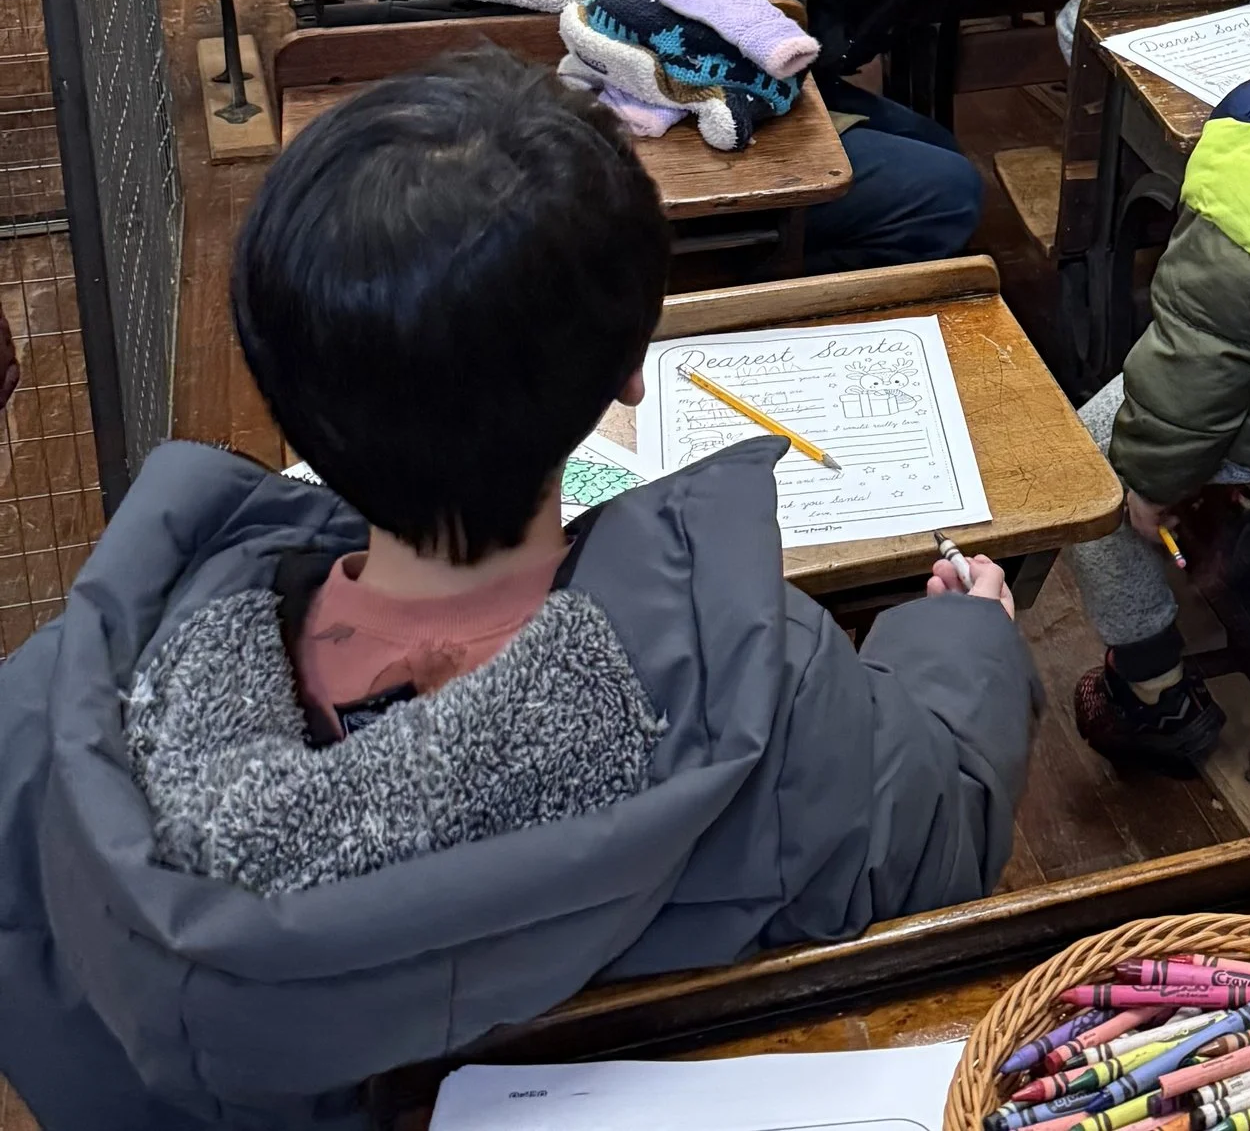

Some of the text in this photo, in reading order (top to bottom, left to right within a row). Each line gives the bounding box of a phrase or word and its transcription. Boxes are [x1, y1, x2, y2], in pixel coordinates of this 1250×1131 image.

[1139, 31, 1207, 53] Dearest
[680, 346, 796, 370] Dearest
[810, 339, 910, 360] Santa
[801, 499, 825, 511] you
[829, 491, 872, 504] Santa!
